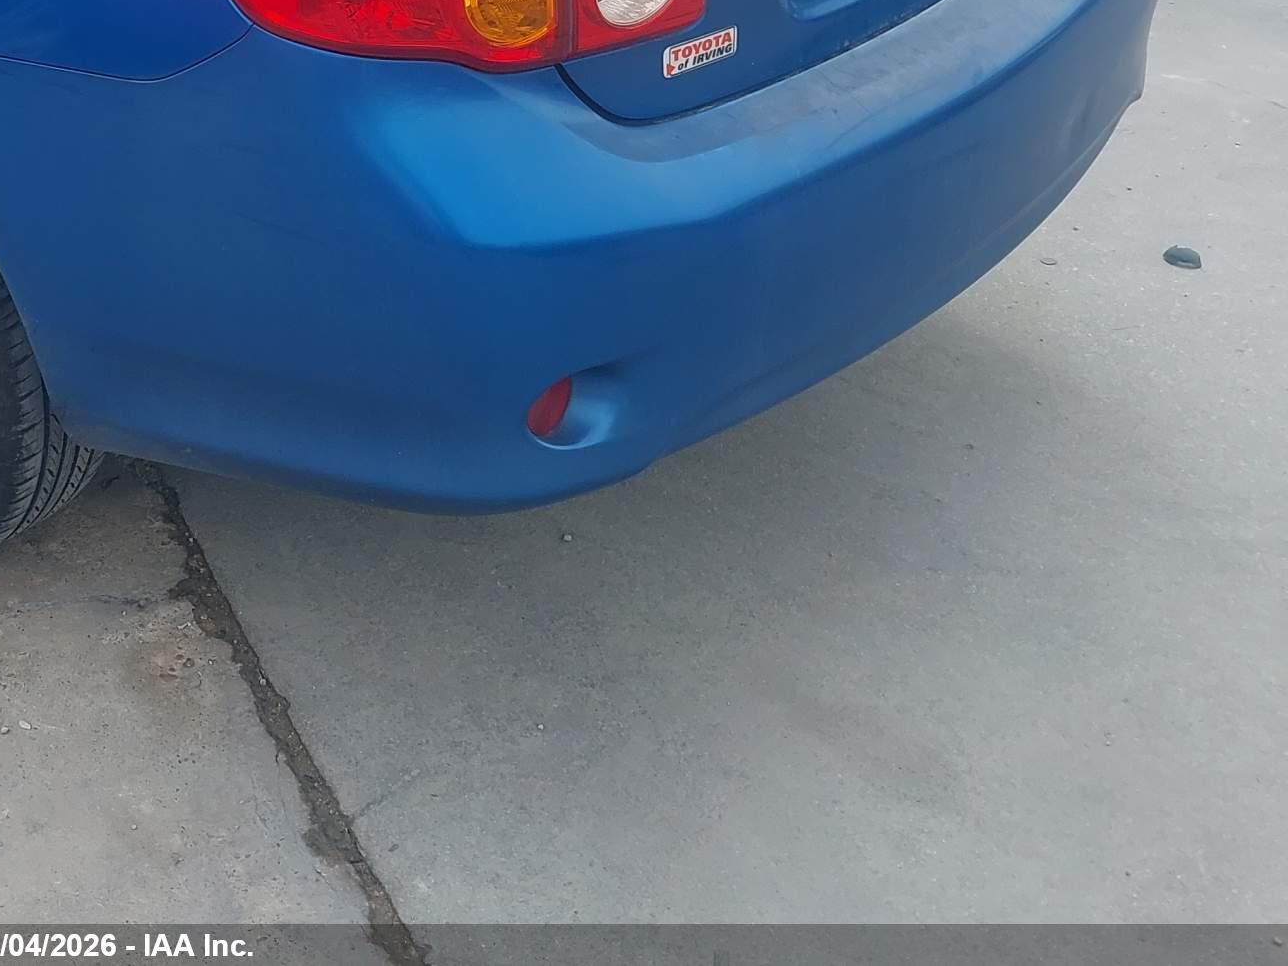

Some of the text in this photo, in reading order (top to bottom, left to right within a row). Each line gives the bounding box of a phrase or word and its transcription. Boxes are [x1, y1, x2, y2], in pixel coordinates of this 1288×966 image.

[672, 32, 732, 61] TOYOTA
[677, 43, 732, 71] of IRVING
